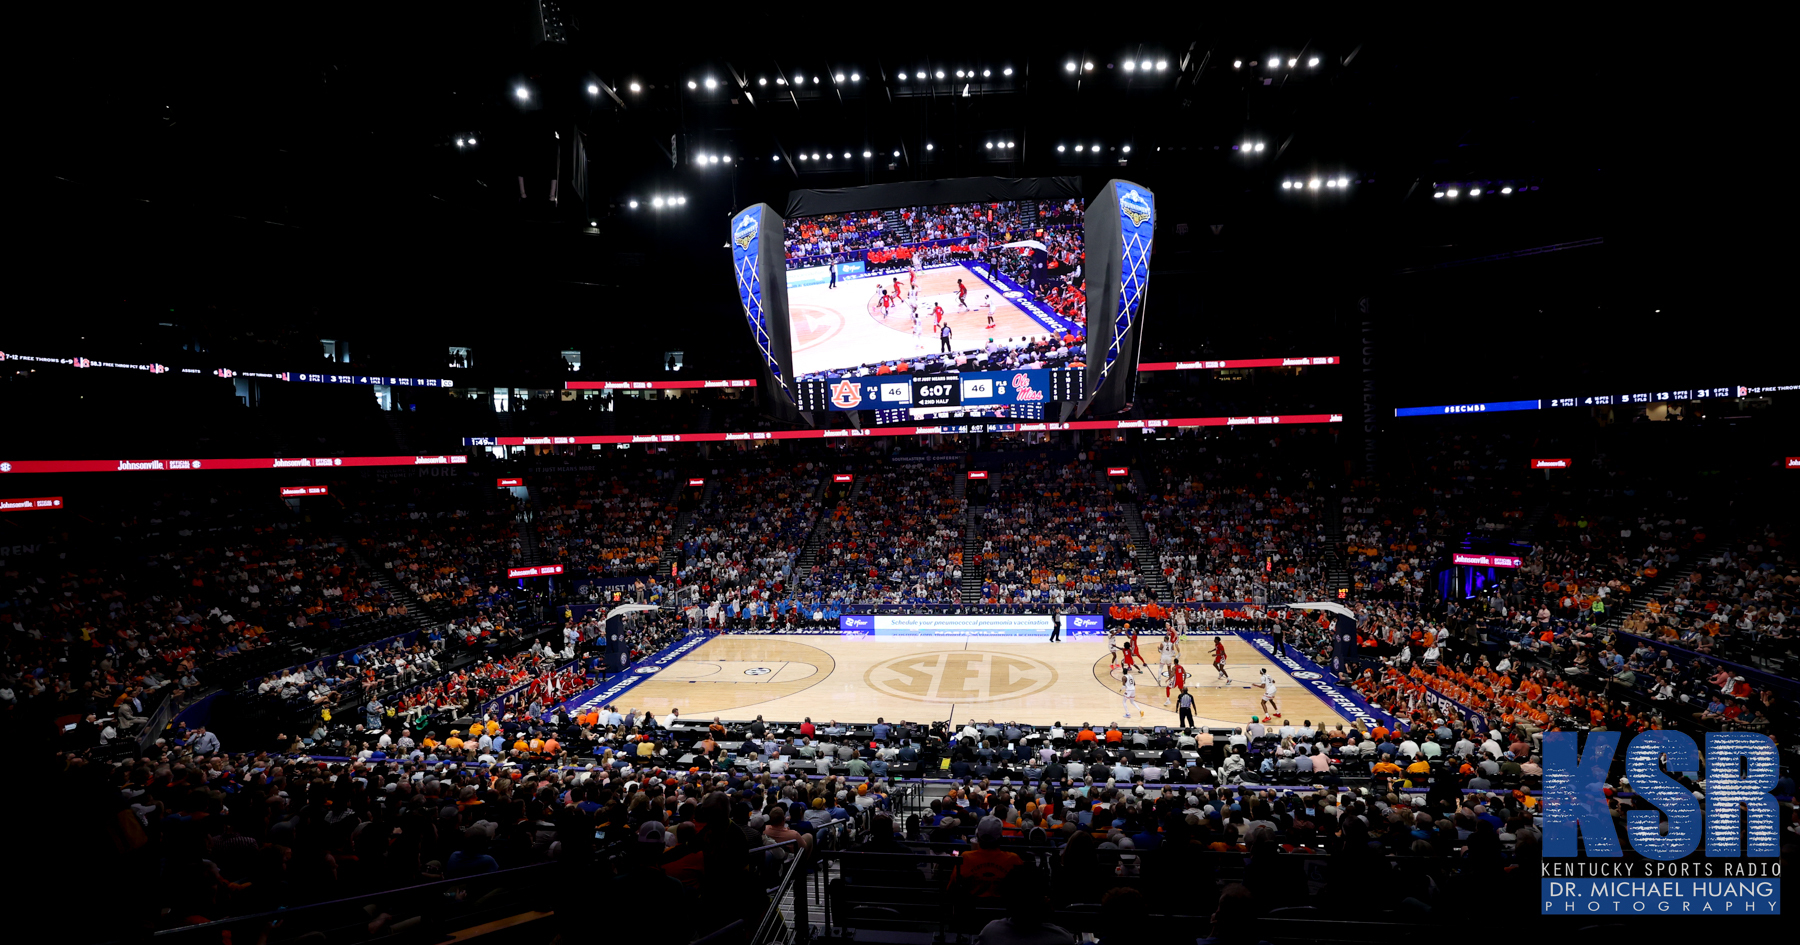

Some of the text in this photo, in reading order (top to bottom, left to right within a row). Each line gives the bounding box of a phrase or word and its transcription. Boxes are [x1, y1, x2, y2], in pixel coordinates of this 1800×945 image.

[1012, 373, 1030, 388] Ole
[920, 385, 952, 396] 6:07
[998, 386, 1006, 394] 8
[1016, 386, 1044, 401] Miss
[1697, 389, 1710, 398] 31
[869, 392, 876, 400] 6
[1656, 392, 1669, 400] 13
[1444, 404, 1486, 414] #SECMBB
[273, 458, 311, 467] Johnsonville
[415, 456, 448, 464] Johnsonville
[118, 460, 164, 470] Johnsonville
[419, 467, 457, 477] MORE
[1455, 555, 1490, 564] Johnsonville
[509, 567, 538, 577] Johnsonville
[854, 619, 868, 627] Pfizer
[934, 619, 977, 627] pneumococcal
[978, 619, 1012, 627] pneumonia
[885, 654, 1038, 698] SEC
[1311, 680, 1378, 728] CONFERENCE
